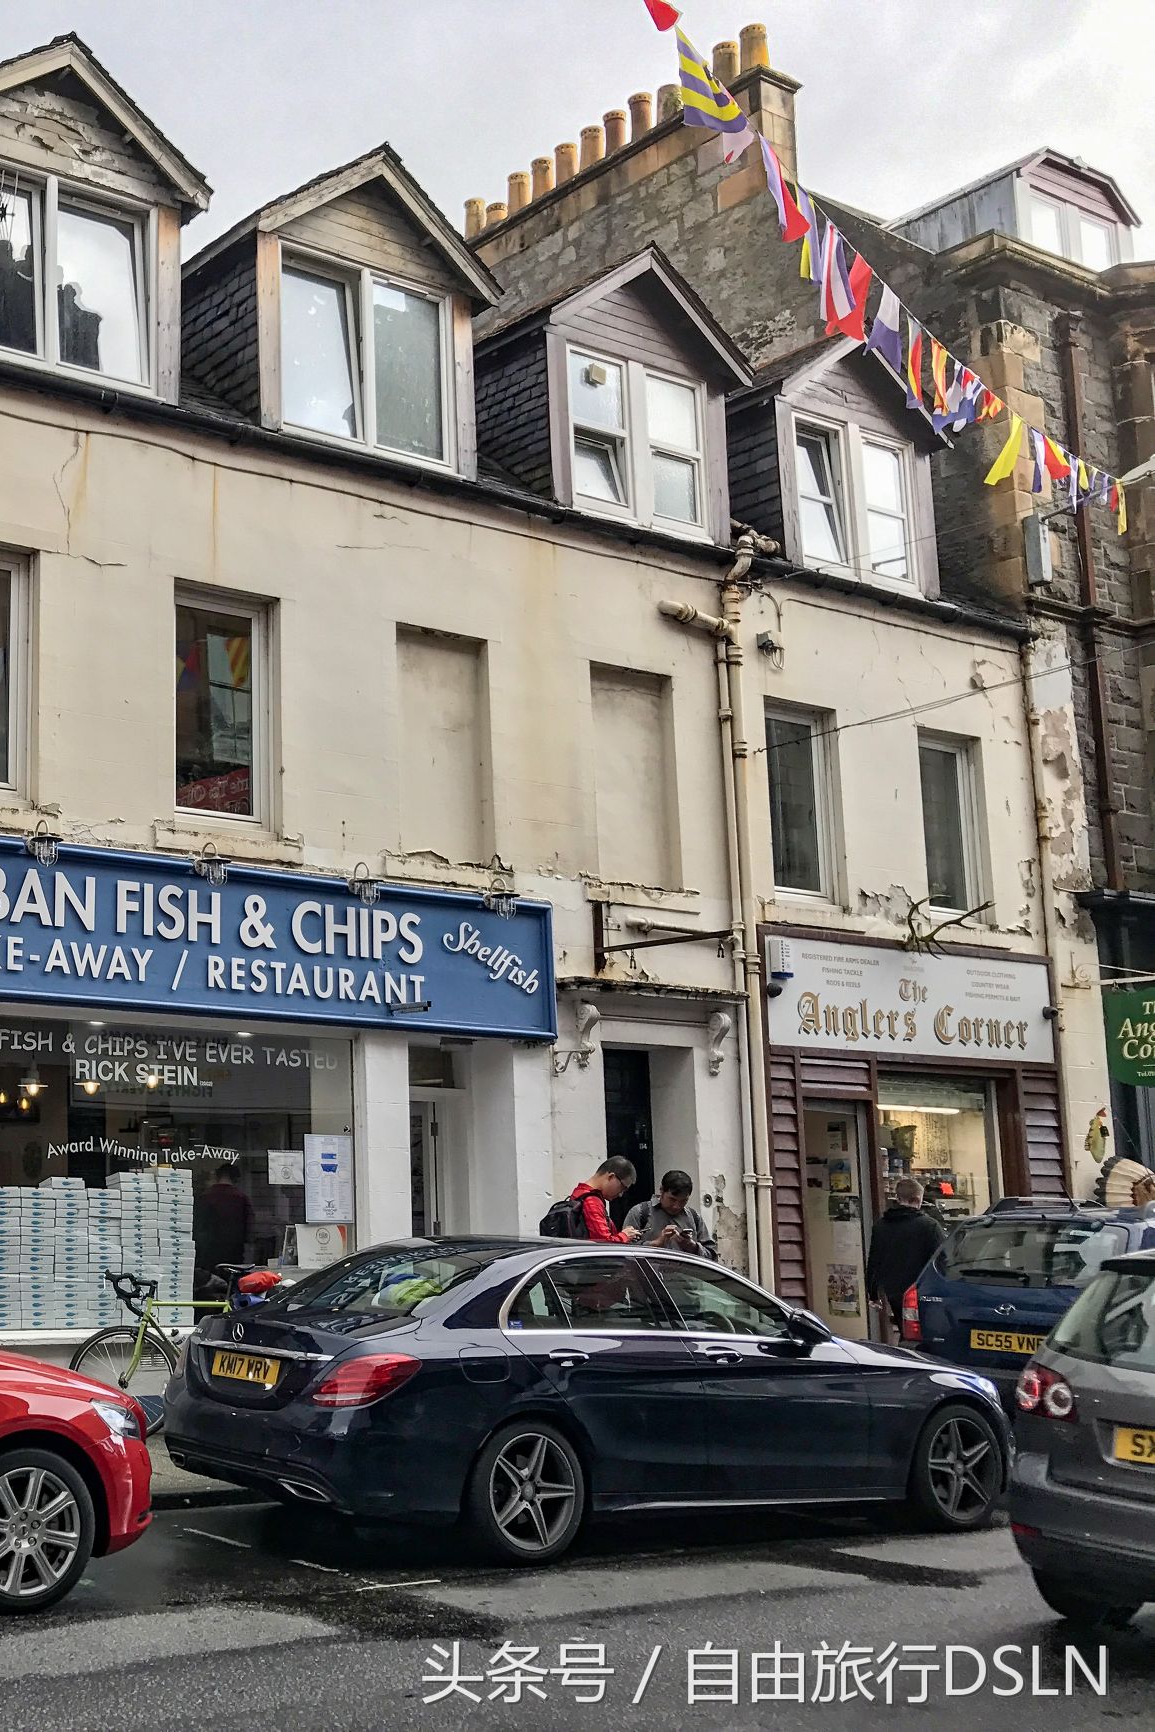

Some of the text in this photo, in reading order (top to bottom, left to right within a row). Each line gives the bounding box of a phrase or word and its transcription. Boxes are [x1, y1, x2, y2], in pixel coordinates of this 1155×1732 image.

[116, 880, 222, 945] FISH
[239, 894, 278, 949] &
[291, 900, 424, 964] CHIPS
[171, 949, 189, 991] /
[207, 955, 425, 1004] RESTAURANT
[442, 921, 539, 994] Shellfish
[899, 978, 928, 1005] The
[933, 1004, 1029, 1051] Corner
[61, 1032, 76, 1054] &
[84, 1034, 149, 1060] CHIPS
[156, 1039, 198, 1062] I'VE
[205, 1041, 255, 1065] EVER
[262, 1046, 338, 1071] TASTED
[75, 1058, 130, 1082] RICK
[135, 1063, 198, 1087] STEIN
[47, 1135, 240, 1167] Award Winning Take-Away
[976, 1332, 1013, 1349] SC55
